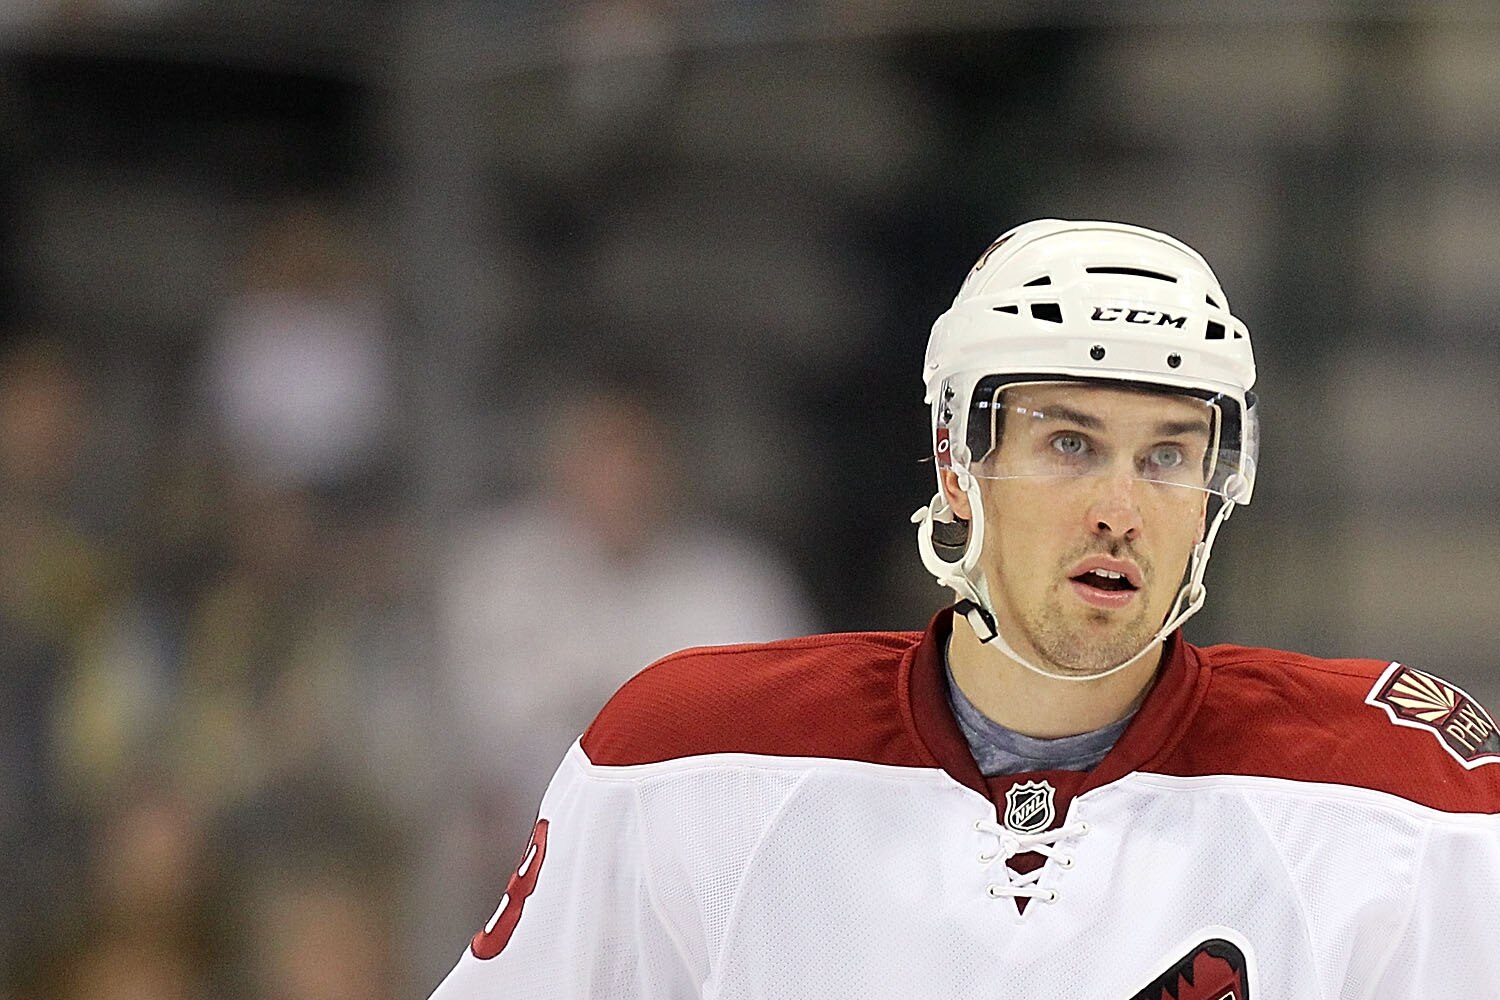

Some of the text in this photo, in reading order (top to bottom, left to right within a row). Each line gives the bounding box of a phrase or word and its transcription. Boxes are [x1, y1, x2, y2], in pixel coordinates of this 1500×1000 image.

[1091, 306, 1187, 329] CCM
[1447, 703, 1493, 752] PHX
[1014, 794, 1044, 825] NHL
